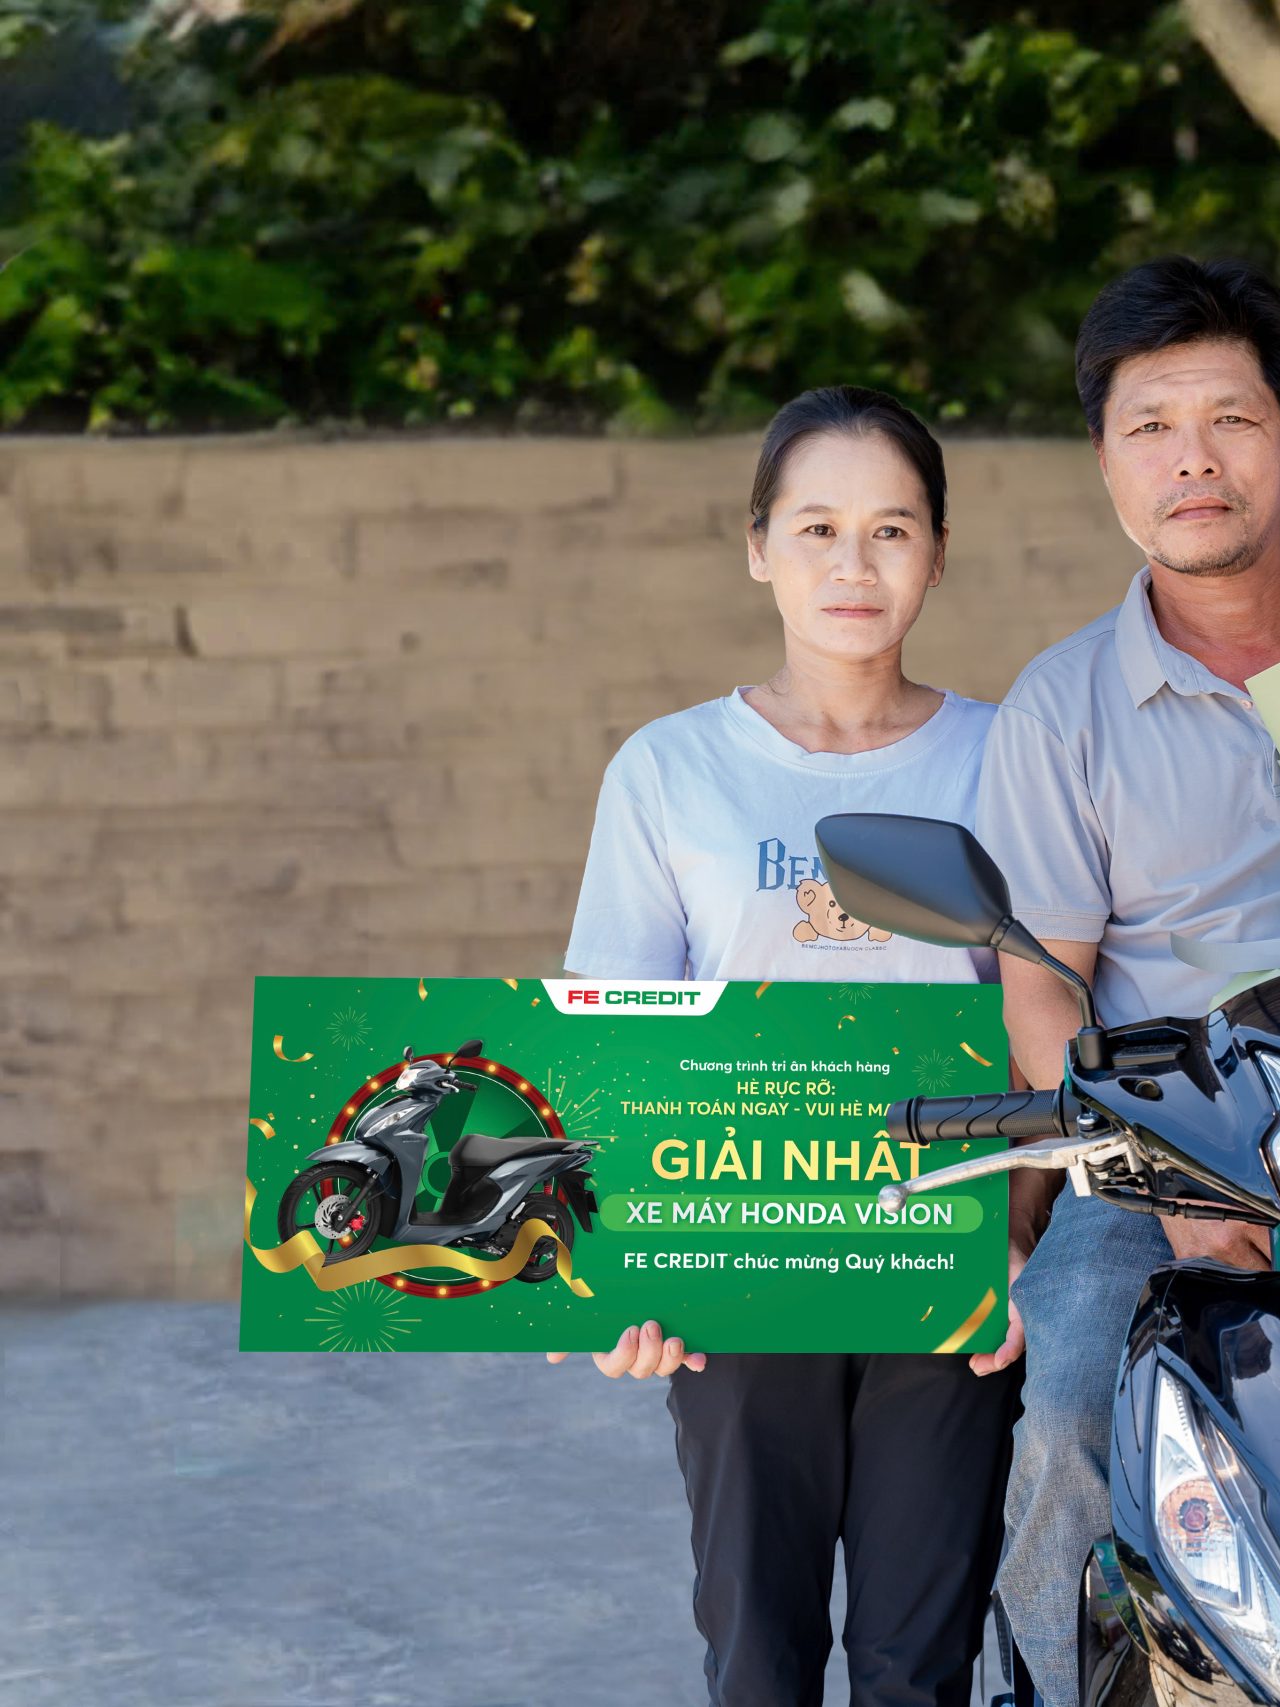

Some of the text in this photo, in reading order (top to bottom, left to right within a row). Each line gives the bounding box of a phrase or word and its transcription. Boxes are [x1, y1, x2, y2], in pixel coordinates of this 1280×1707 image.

[568, 990, 701, 1006] FE CREDIT
[679, 1059, 890, 1076] Chương trình tri ân khách hàng
[737, 1078, 836, 1099] HÈ RỰC RỠ:
[620, 1101, 682, 1115] THANH
[687, 1098, 736, 1116] TOÁN
[741, 1102, 789, 1116] NGAY
[805, 1102, 835, 1117] VUI
[840, 1099, 863, 1117] HÈ
[651, 1126, 762, 1181] GIẢI
[626, 1201, 663, 1224] XE
[672, 1197, 732, 1224] MÁY
[741, 1202, 846, 1225] HONDA
[624, 1253, 954, 1274] FE CREDIT chúc mừng Quý khách!
